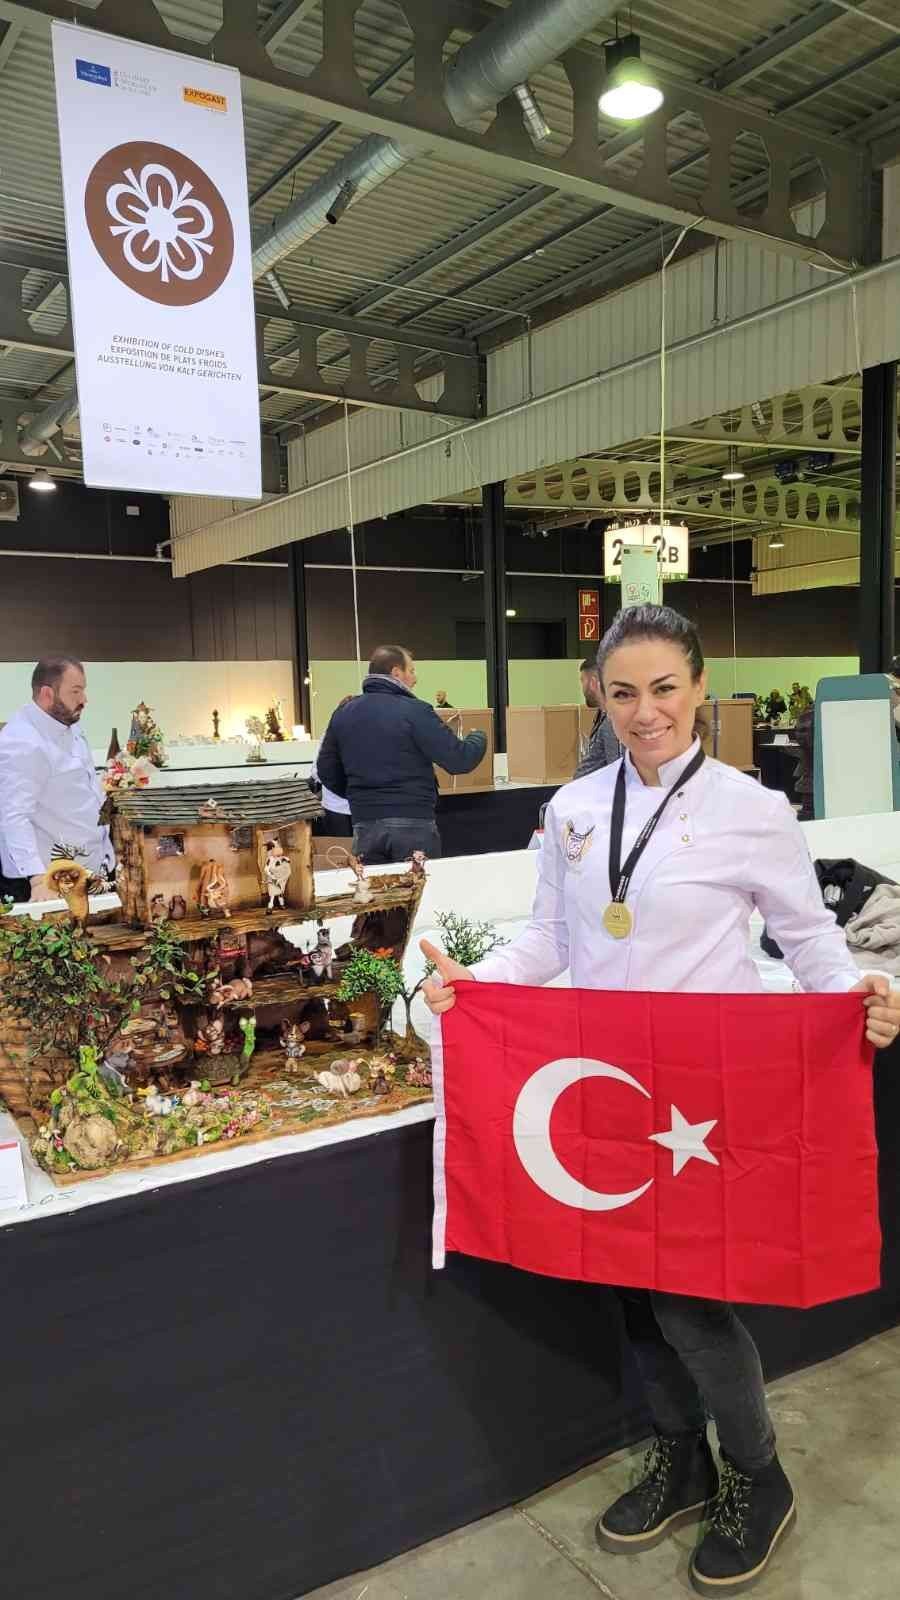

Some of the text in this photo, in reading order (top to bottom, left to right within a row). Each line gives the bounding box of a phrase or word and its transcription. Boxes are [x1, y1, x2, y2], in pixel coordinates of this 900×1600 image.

[184, 87, 226, 105] EXPOGAST
[110, 345, 227, 369] EXPOSITION DE PLATS FROIDS
[112, 335, 225, 358] EXHIBITION OF COLD DISHES
[97, 354, 157, 370] AUSSTELLUNG
[158, 363, 175, 373] VON
[197, 369, 242, 381] GERICHTEN
[652, 535, 679, 563] 2B
